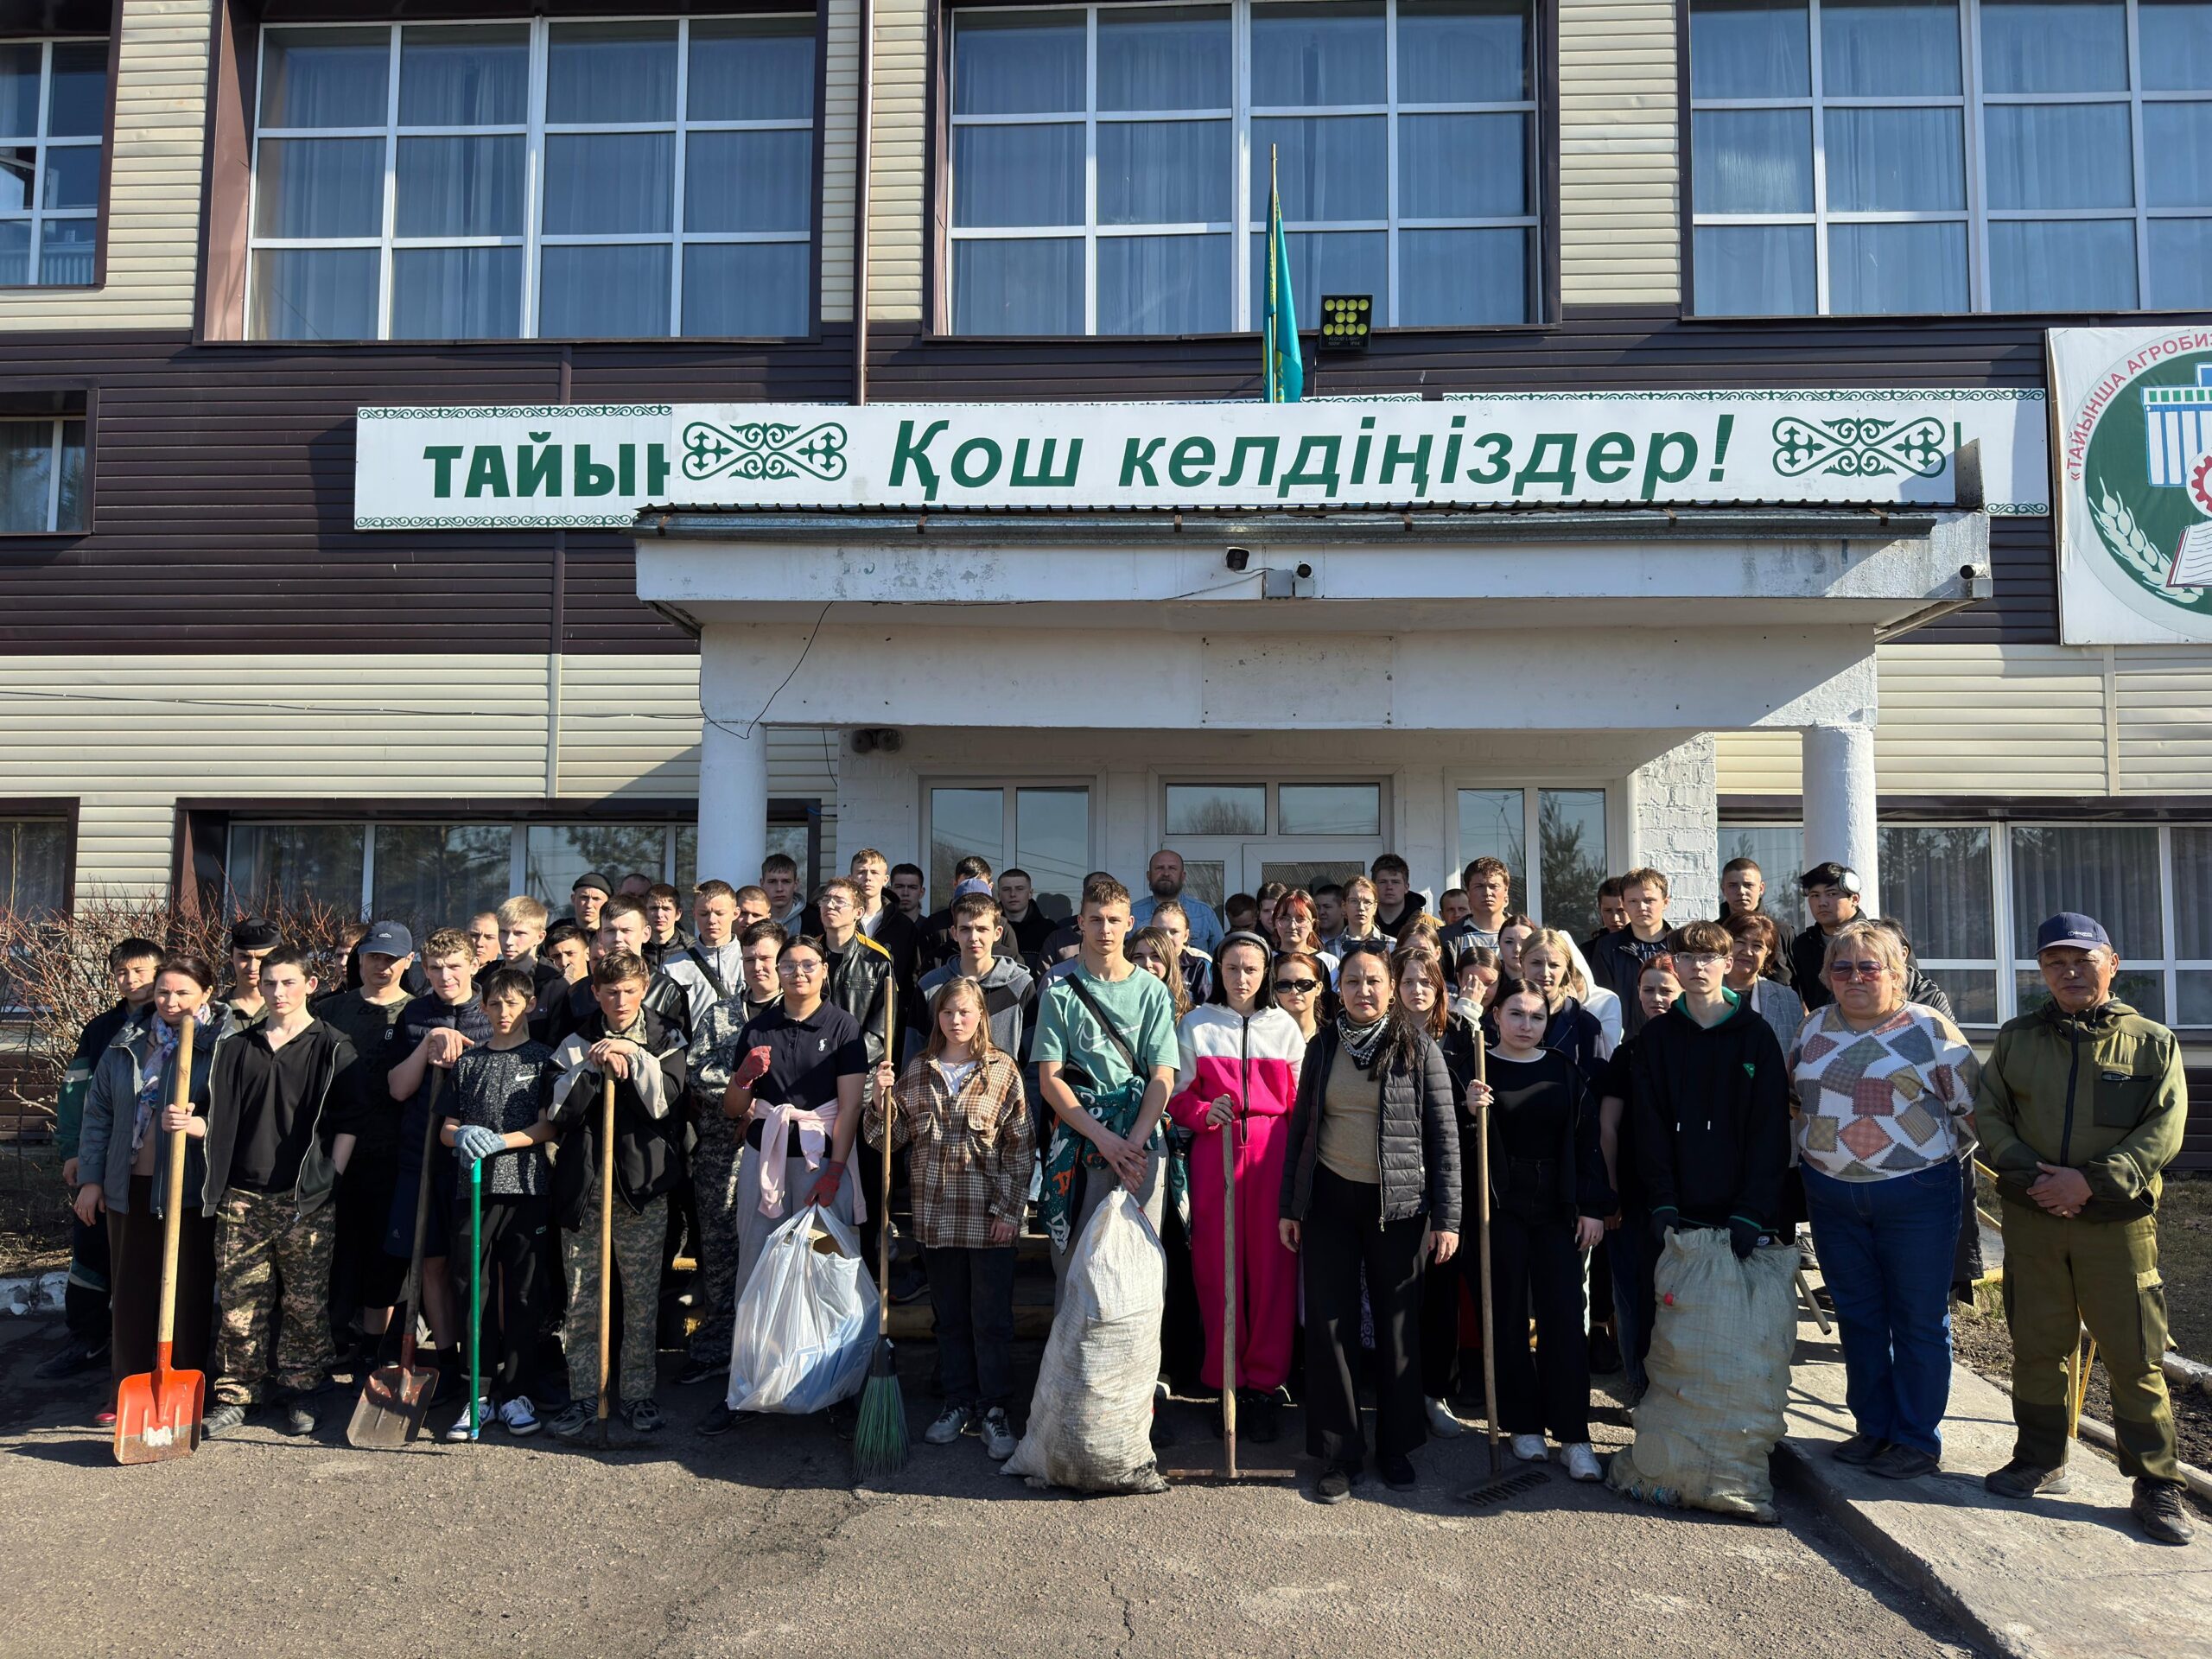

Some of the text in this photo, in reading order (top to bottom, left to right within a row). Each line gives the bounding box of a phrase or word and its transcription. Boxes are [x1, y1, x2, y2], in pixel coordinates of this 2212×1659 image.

[2126, 333, 2212, 375] АГРОБИ
[888, 414, 1735, 501] Қош келдіңіздер!
